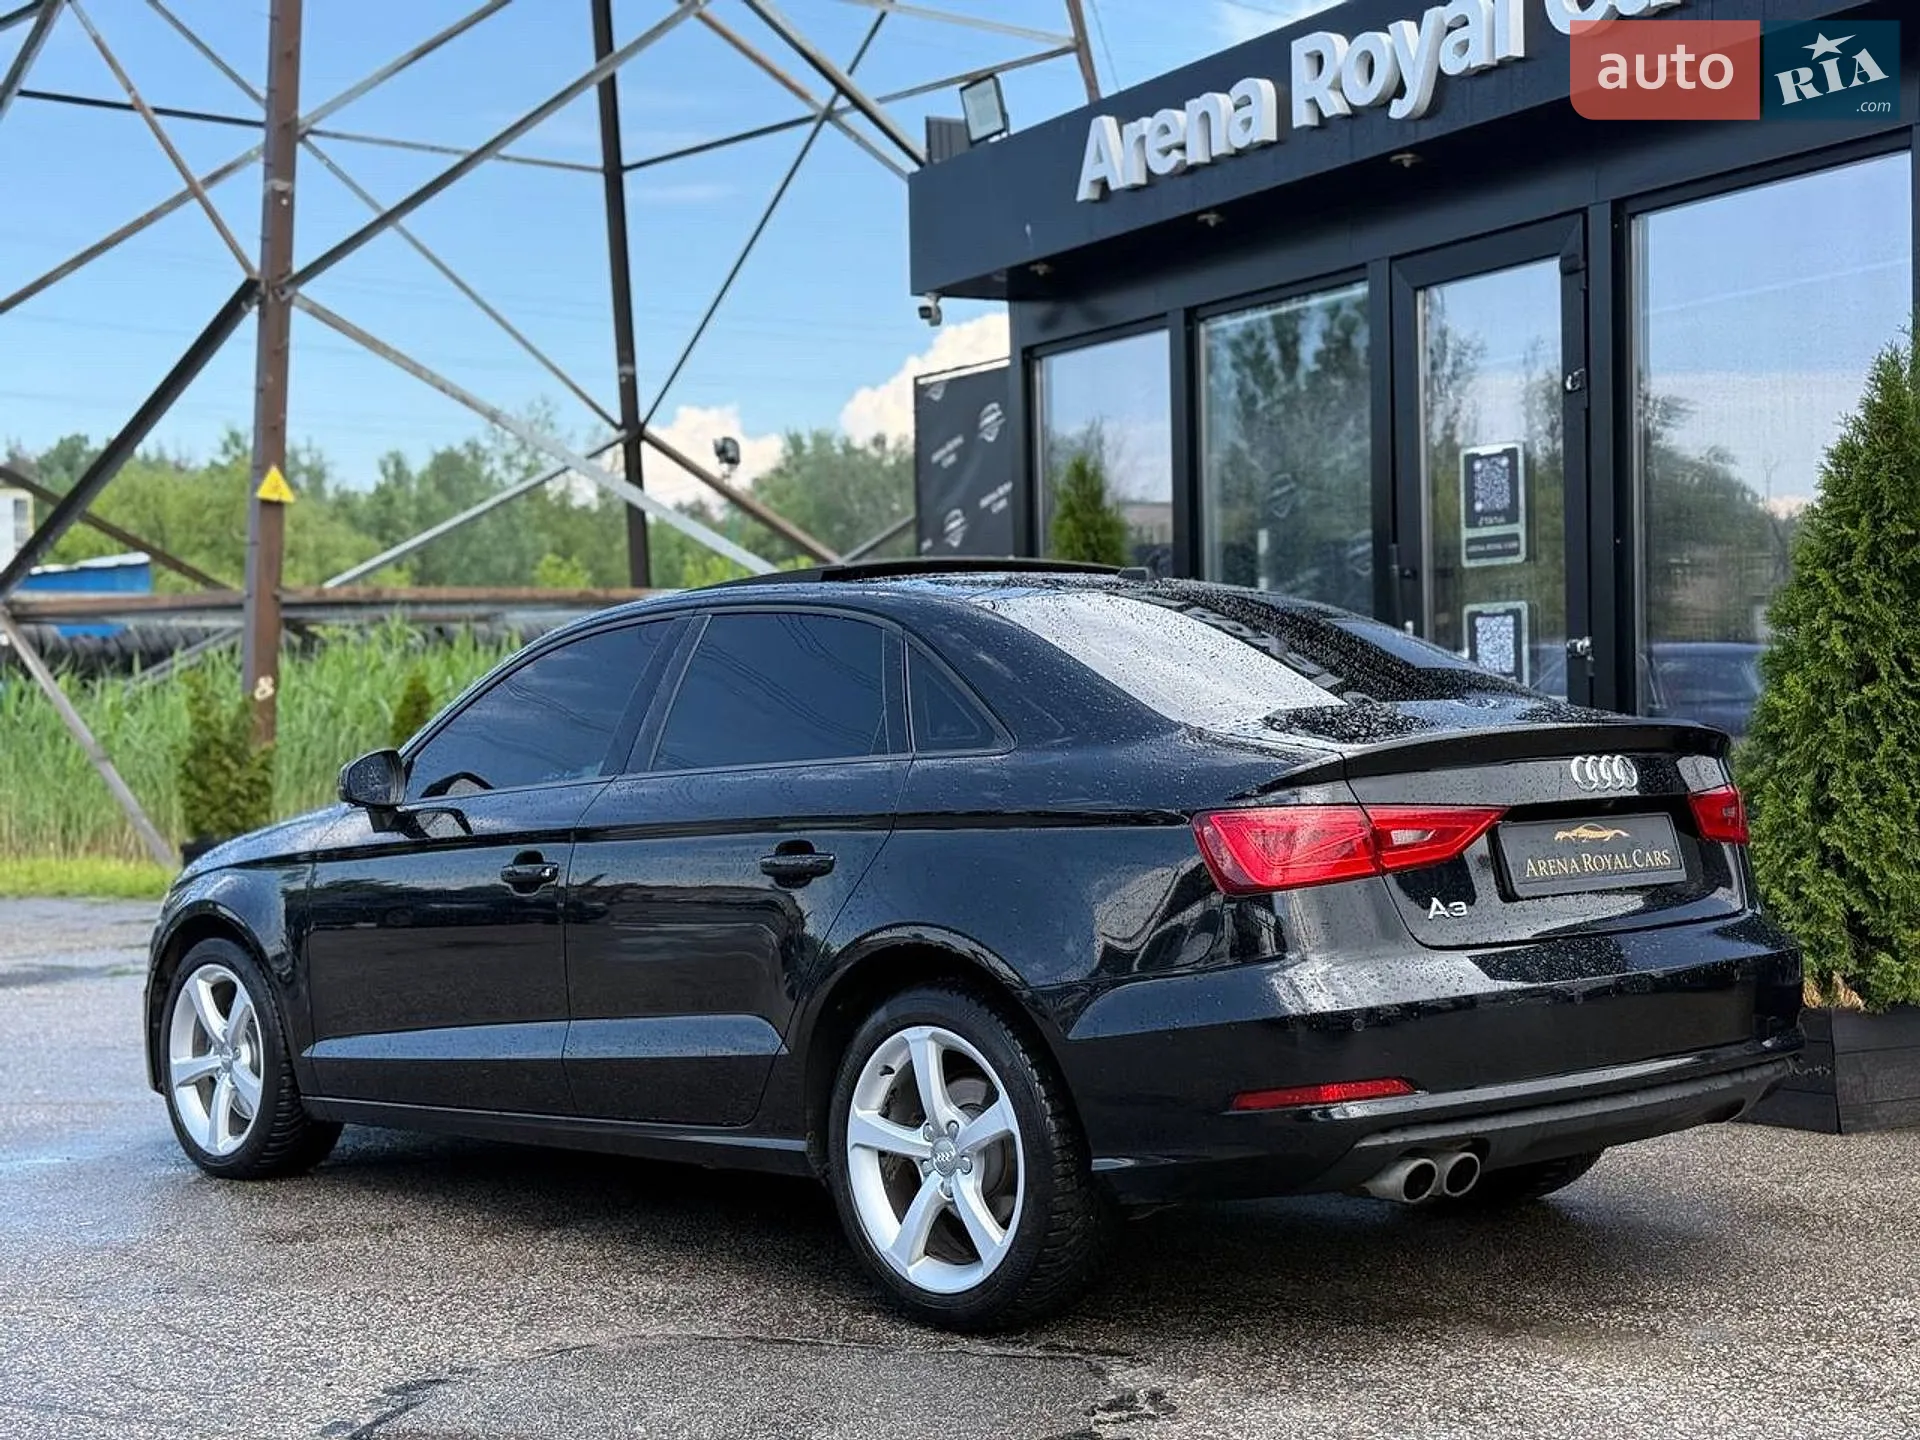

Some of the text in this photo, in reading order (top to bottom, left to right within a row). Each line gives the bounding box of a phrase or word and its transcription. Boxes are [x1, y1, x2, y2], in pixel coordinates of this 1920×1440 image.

[1077, 0, 1525, 202] Arena Royal
[1525, 847, 1671, 878] ARENA ROYAL CARS
[1428, 896, 1468, 919] A3
